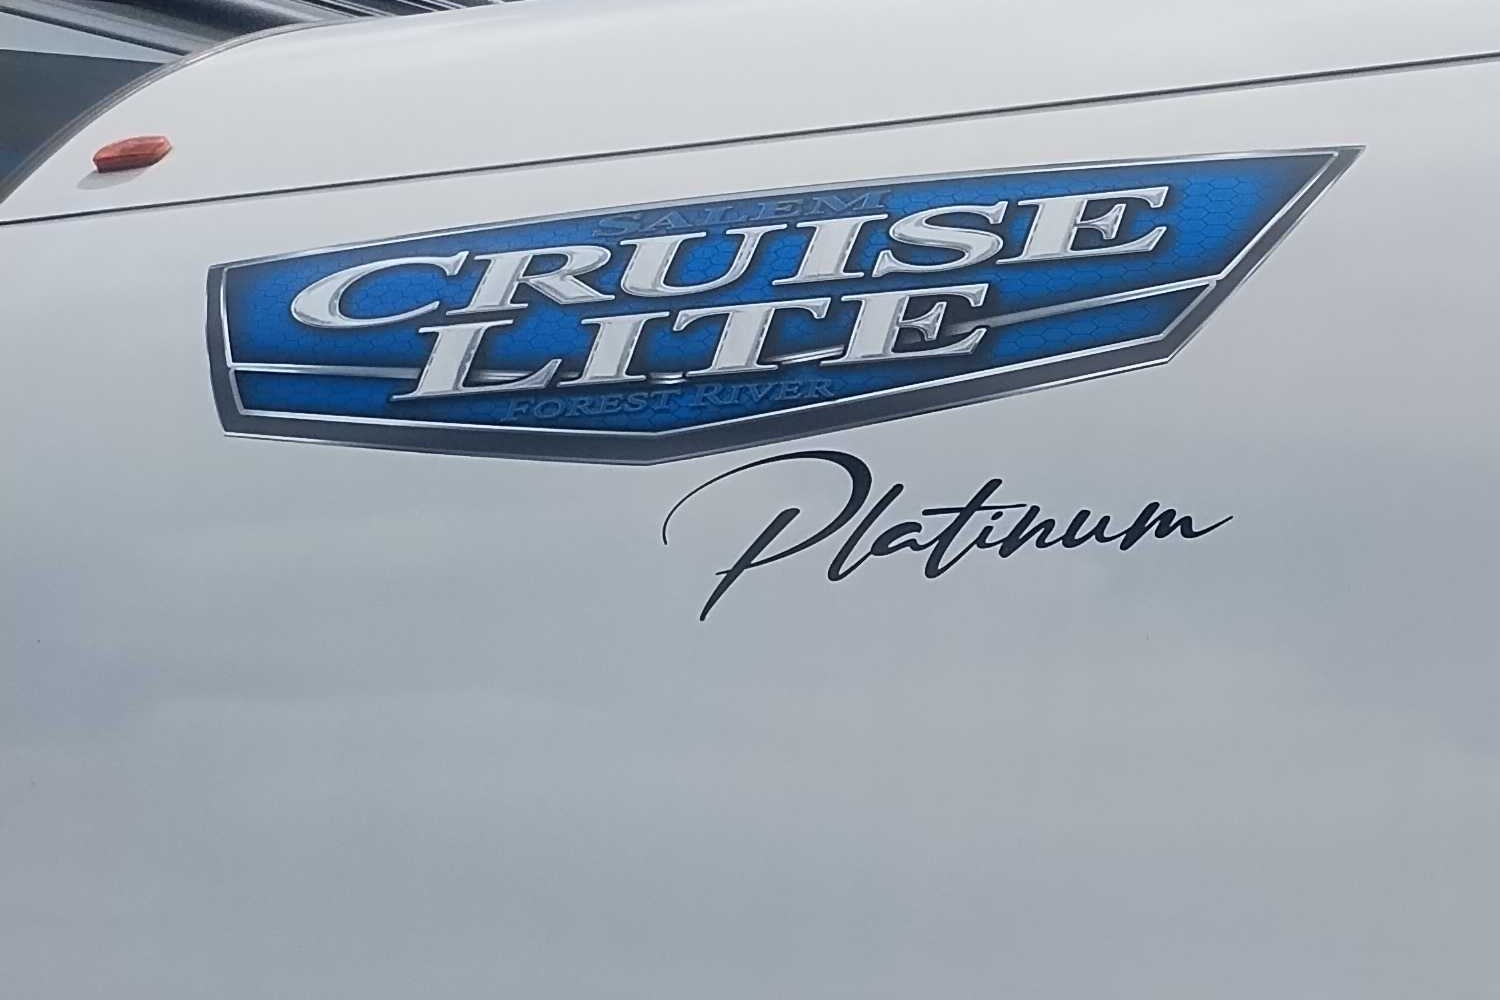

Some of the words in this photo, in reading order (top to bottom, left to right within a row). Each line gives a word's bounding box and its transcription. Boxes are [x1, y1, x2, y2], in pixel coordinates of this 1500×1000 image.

[290, 185, 1170, 329] CRUISE
[592, 189, 891, 238] SALEM
[392, 282, 989, 401] LITE
[501, 388, 683, 422] FOREST
[697, 377, 836, 407] RIVER
[662, 449, 1235, 622] Platinum
